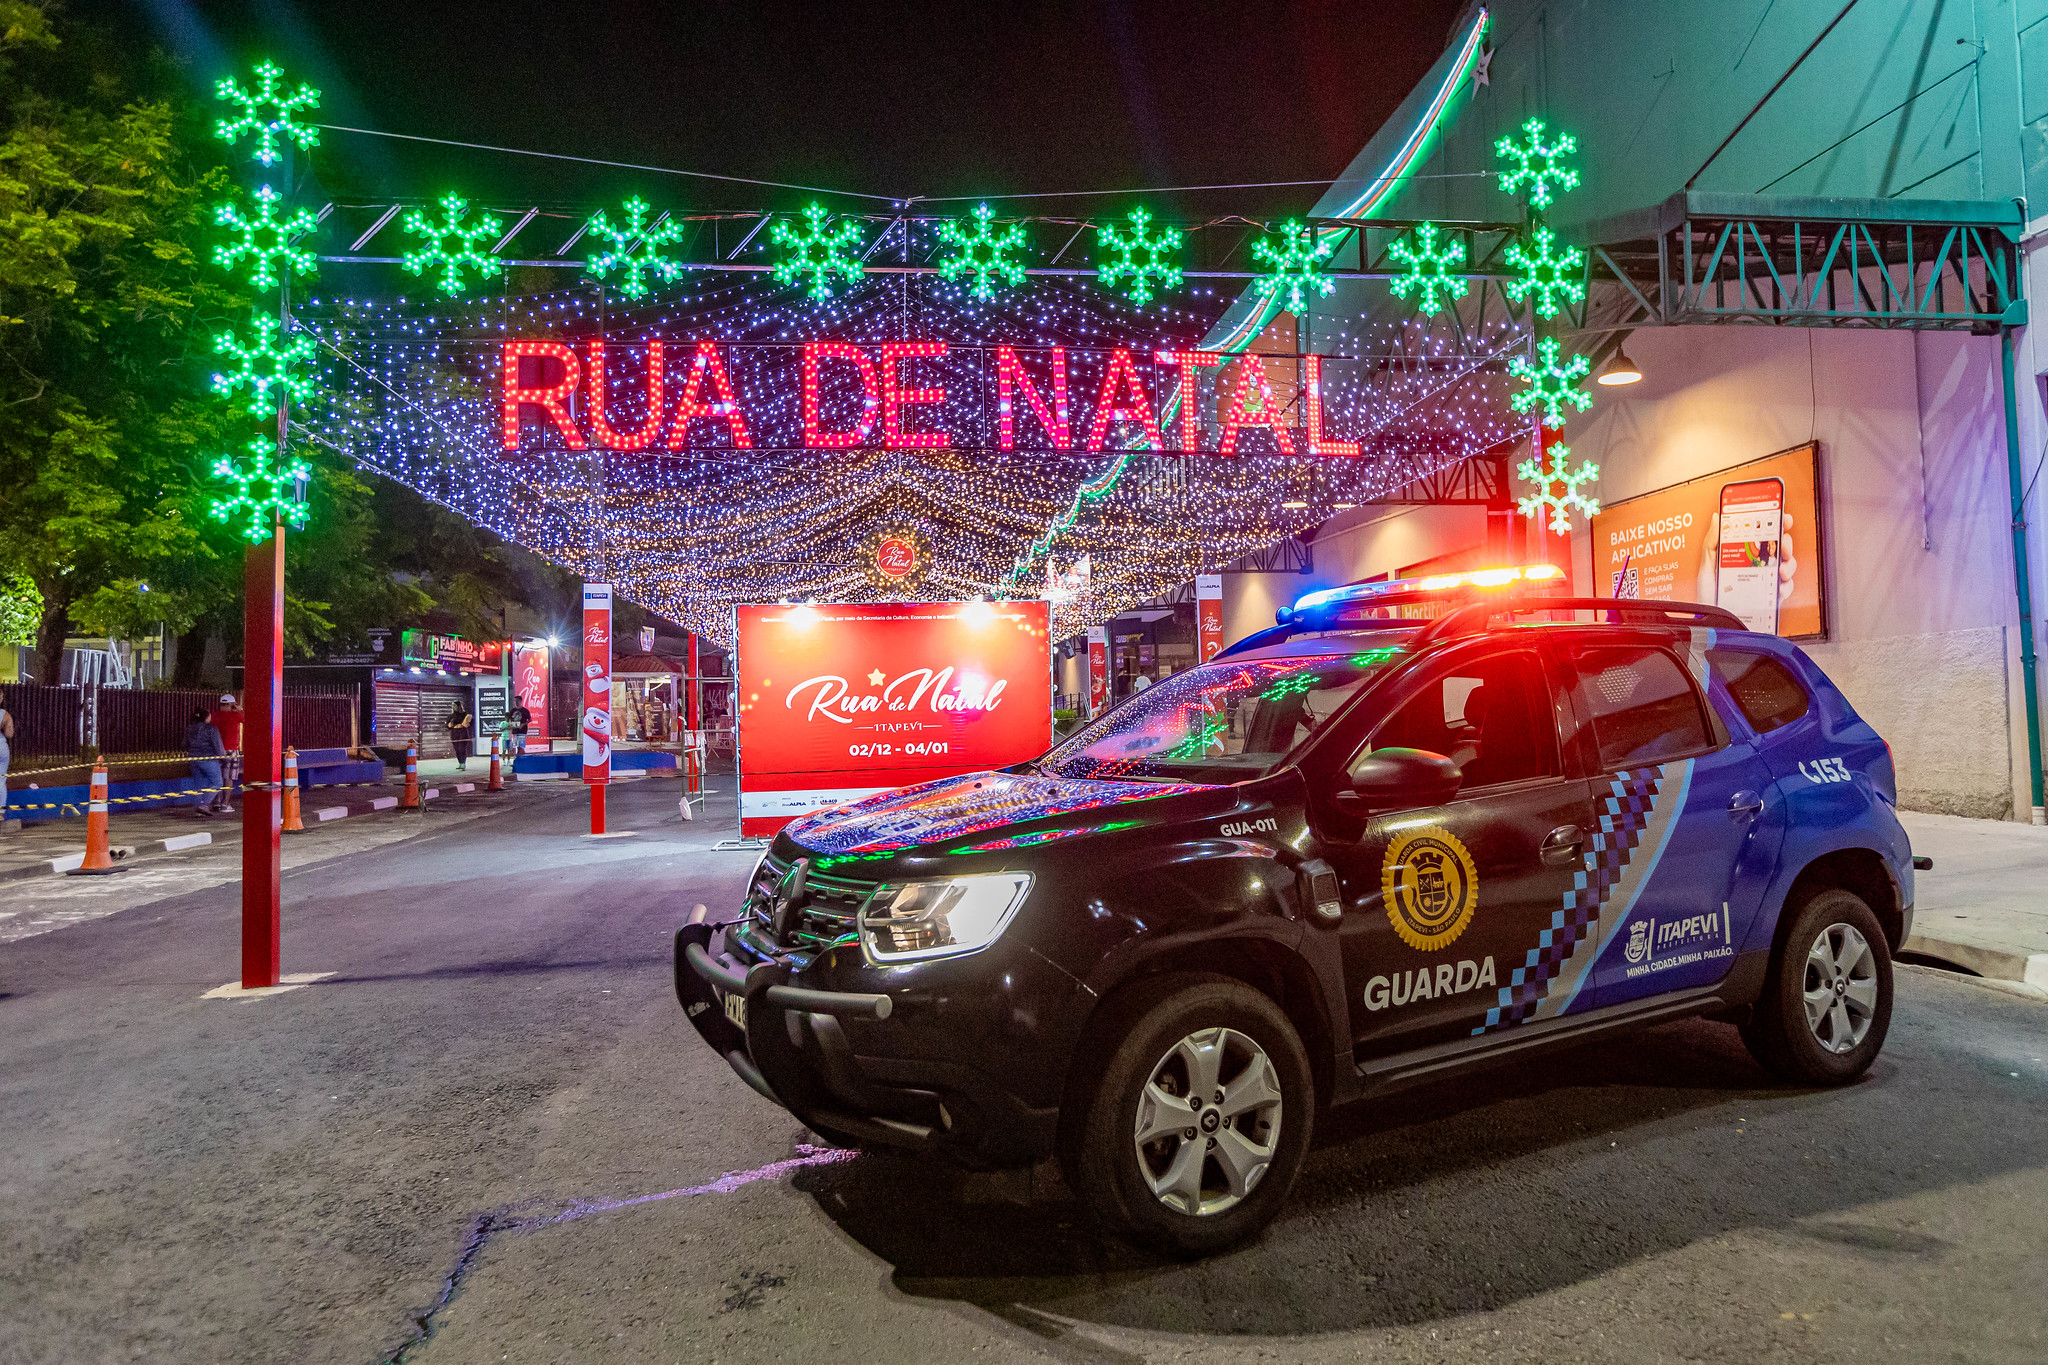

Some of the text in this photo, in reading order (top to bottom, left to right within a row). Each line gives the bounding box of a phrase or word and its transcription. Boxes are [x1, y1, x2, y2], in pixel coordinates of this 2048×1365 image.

[505, 341, 1359, 456] RUA DE NATAL
[1610, 512, 1693, 546] BAIXE NOSSO
[1611, 534, 1686, 564] APLICATIVO!
[1663, 561, 1679, 571] SUAS
[1644, 573, 1674, 585] COMPRAS
[1645, 584, 1672, 596] SEM SAIR
[522, 666, 540, 688] Rua
[518, 686, 546, 709] Natal
[786, 666, 1008, 724] Rua de Natal
[874, 721, 923, 733] ITAPEVI
[849, 742, 891, 757] 02/12
[905, 741, 948, 756] 04/01
[1810, 757, 1852, 784] 153
[1220, 817, 1278, 837] GUA-011
[1413, 839, 1429, 849] CIVIL
[1429, 839, 1459, 864] MUNICIPAL
[1407, 907, 1461, 934] ITAPEVI SÃO PAULO
[1657, 912, 1719, 944] ITAPEVI
[1363, 955, 1497, 1012] GUARDA
[1626, 965, 1650, 978] MINHA
